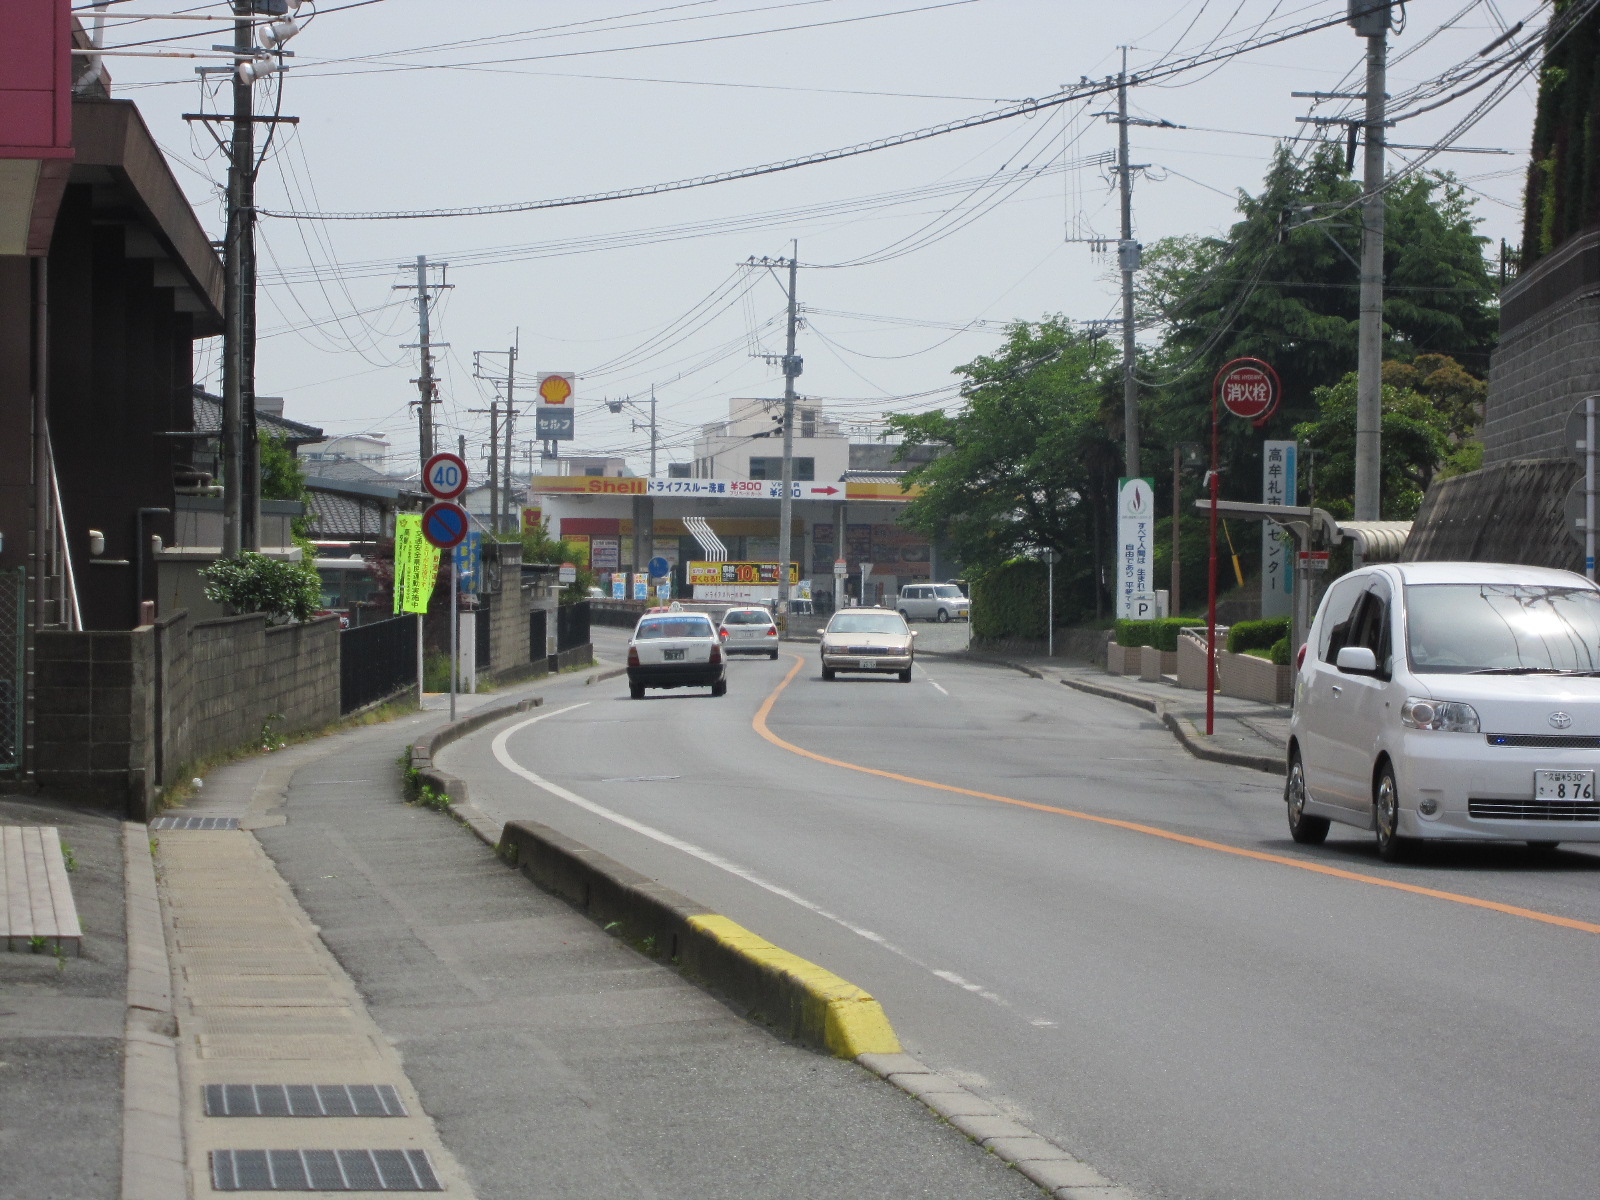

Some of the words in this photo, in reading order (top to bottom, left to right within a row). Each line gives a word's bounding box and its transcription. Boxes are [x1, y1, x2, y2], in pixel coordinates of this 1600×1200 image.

[1227, 383, 1267, 402] 消火栓
[539, 419, 571, 430] セルフ
[433, 466, 458, 487] 40
[589, 479, 643, 493] Shell
[647, 481, 725, 494] ドライブスルー洗車
[731, 481, 762, 491] ¥300
[1138, 602, 1149, 617] P
